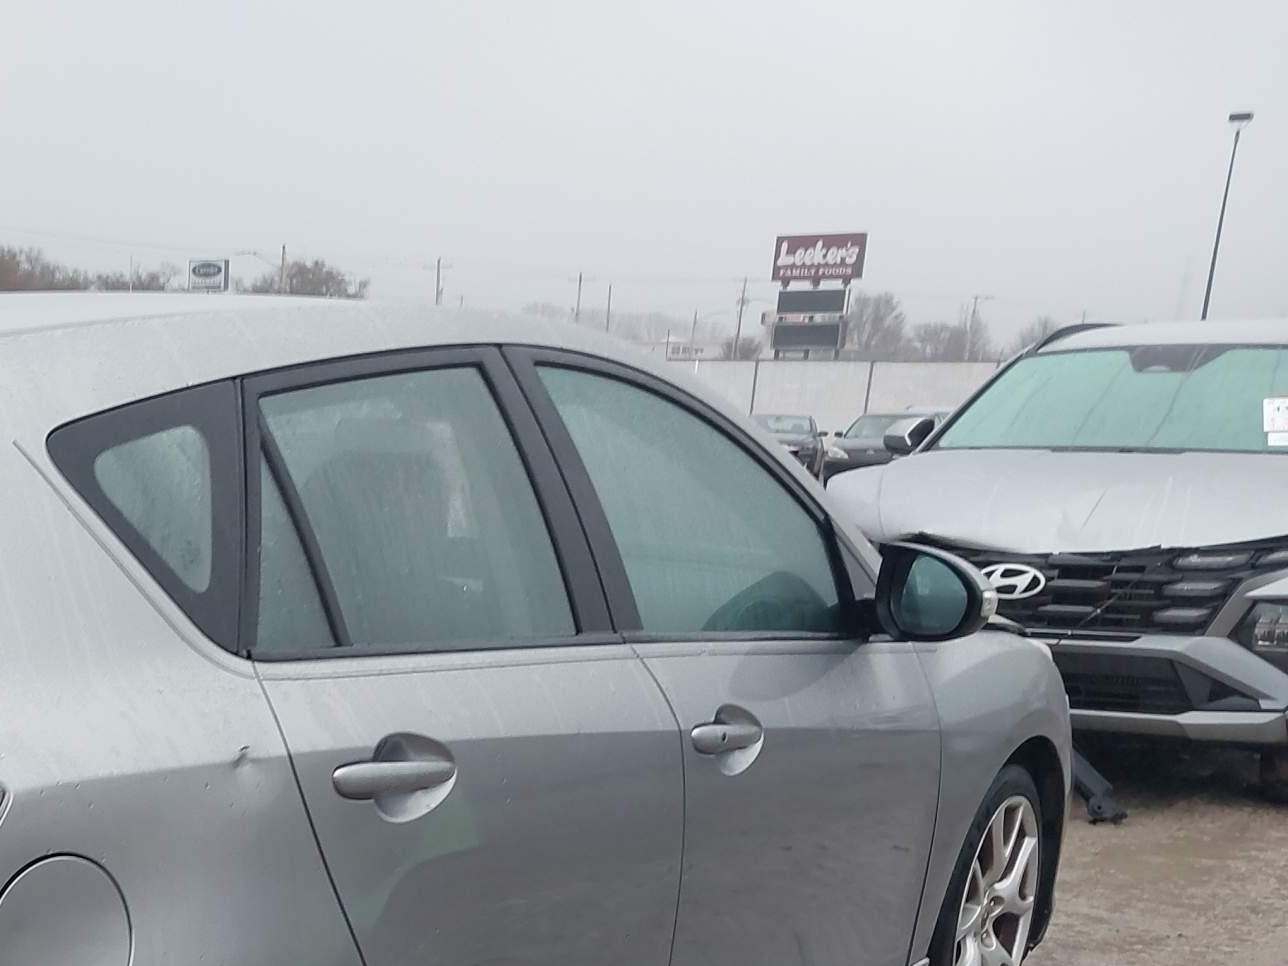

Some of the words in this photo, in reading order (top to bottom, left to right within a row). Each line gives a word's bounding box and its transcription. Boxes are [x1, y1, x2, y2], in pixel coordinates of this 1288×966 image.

[777, 240, 859, 266] Leeker's
[779, 267, 816, 277] FAMILY
[819, 265, 852, 276] FOODS
